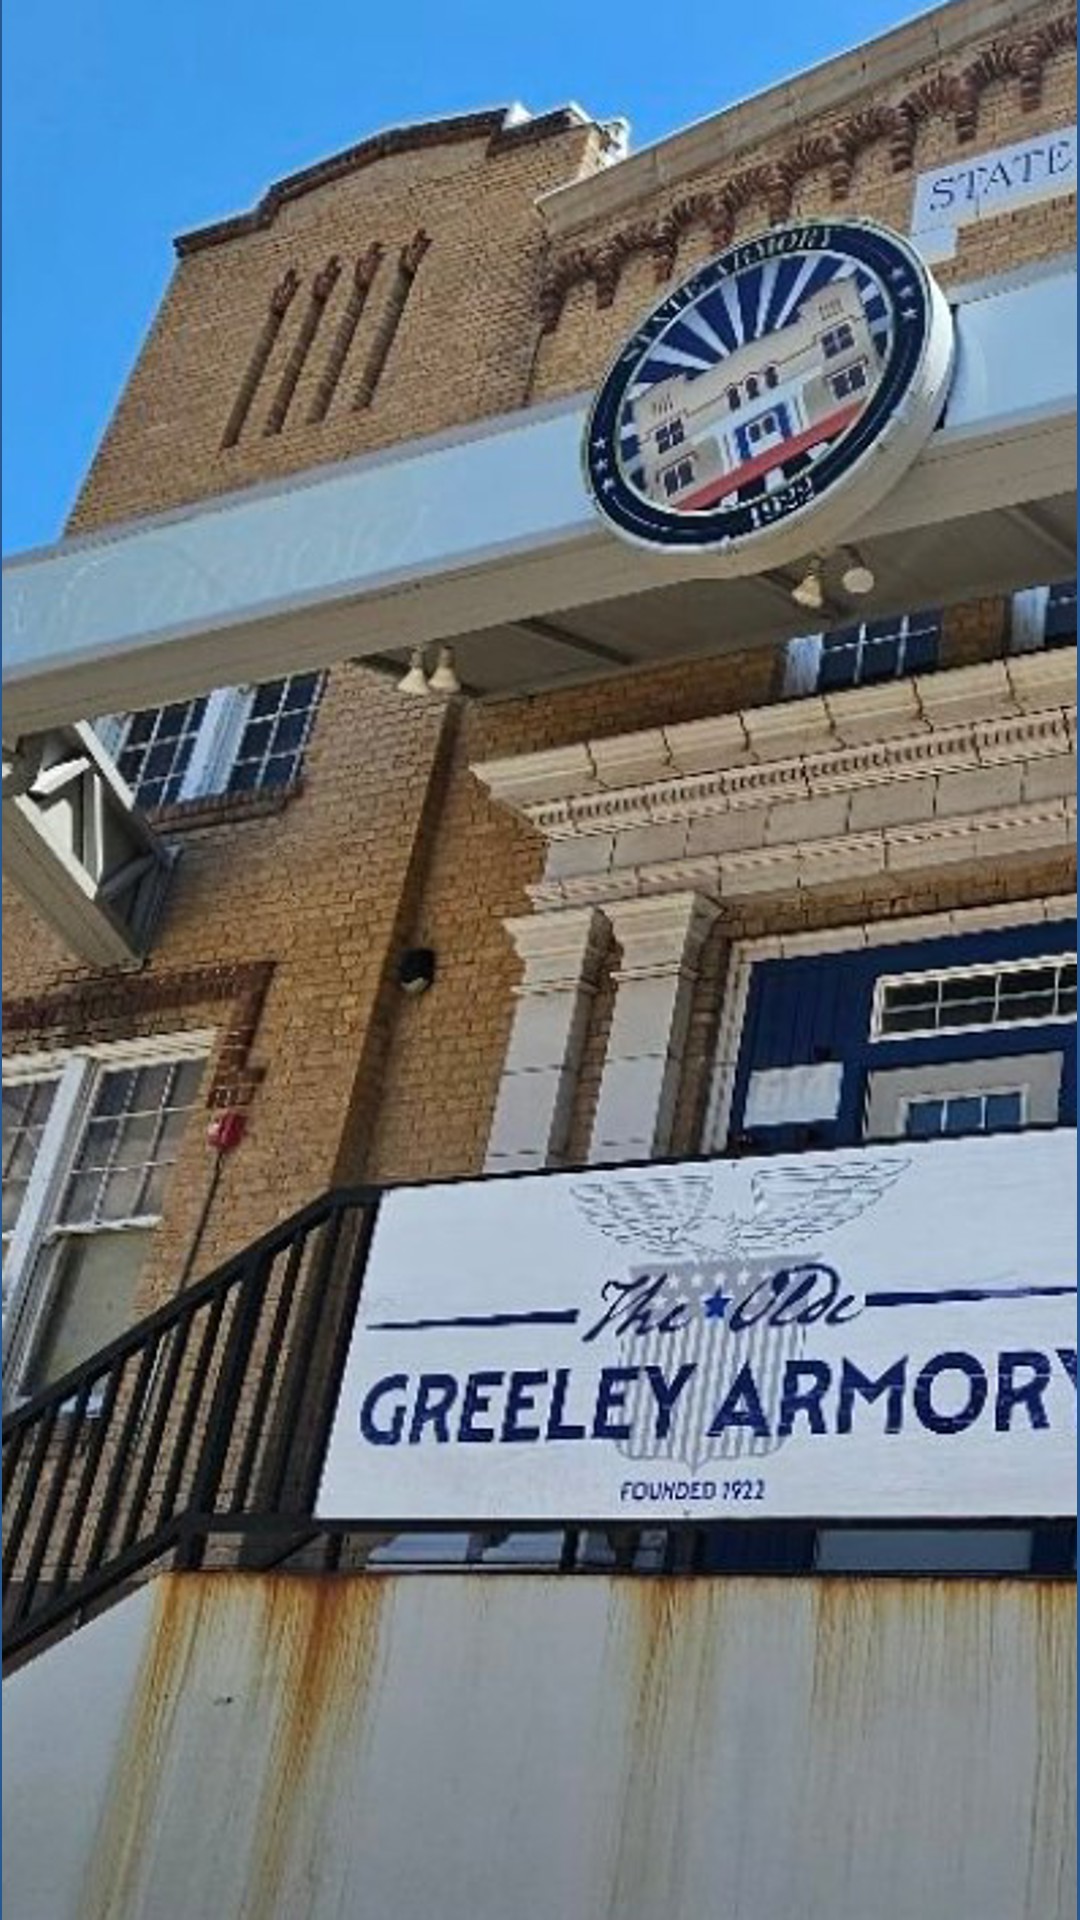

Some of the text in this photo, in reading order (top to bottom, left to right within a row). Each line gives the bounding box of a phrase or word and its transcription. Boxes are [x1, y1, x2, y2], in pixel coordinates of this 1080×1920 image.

[929, 140, 1073, 211] STATE
[749, 475, 815, 528] 1922
[582, 1262, 866, 1342] The Olde
[359, 1363, 698, 1446] GREELEY
[620, 1479, 766, 1501] FOUNDED 1922
